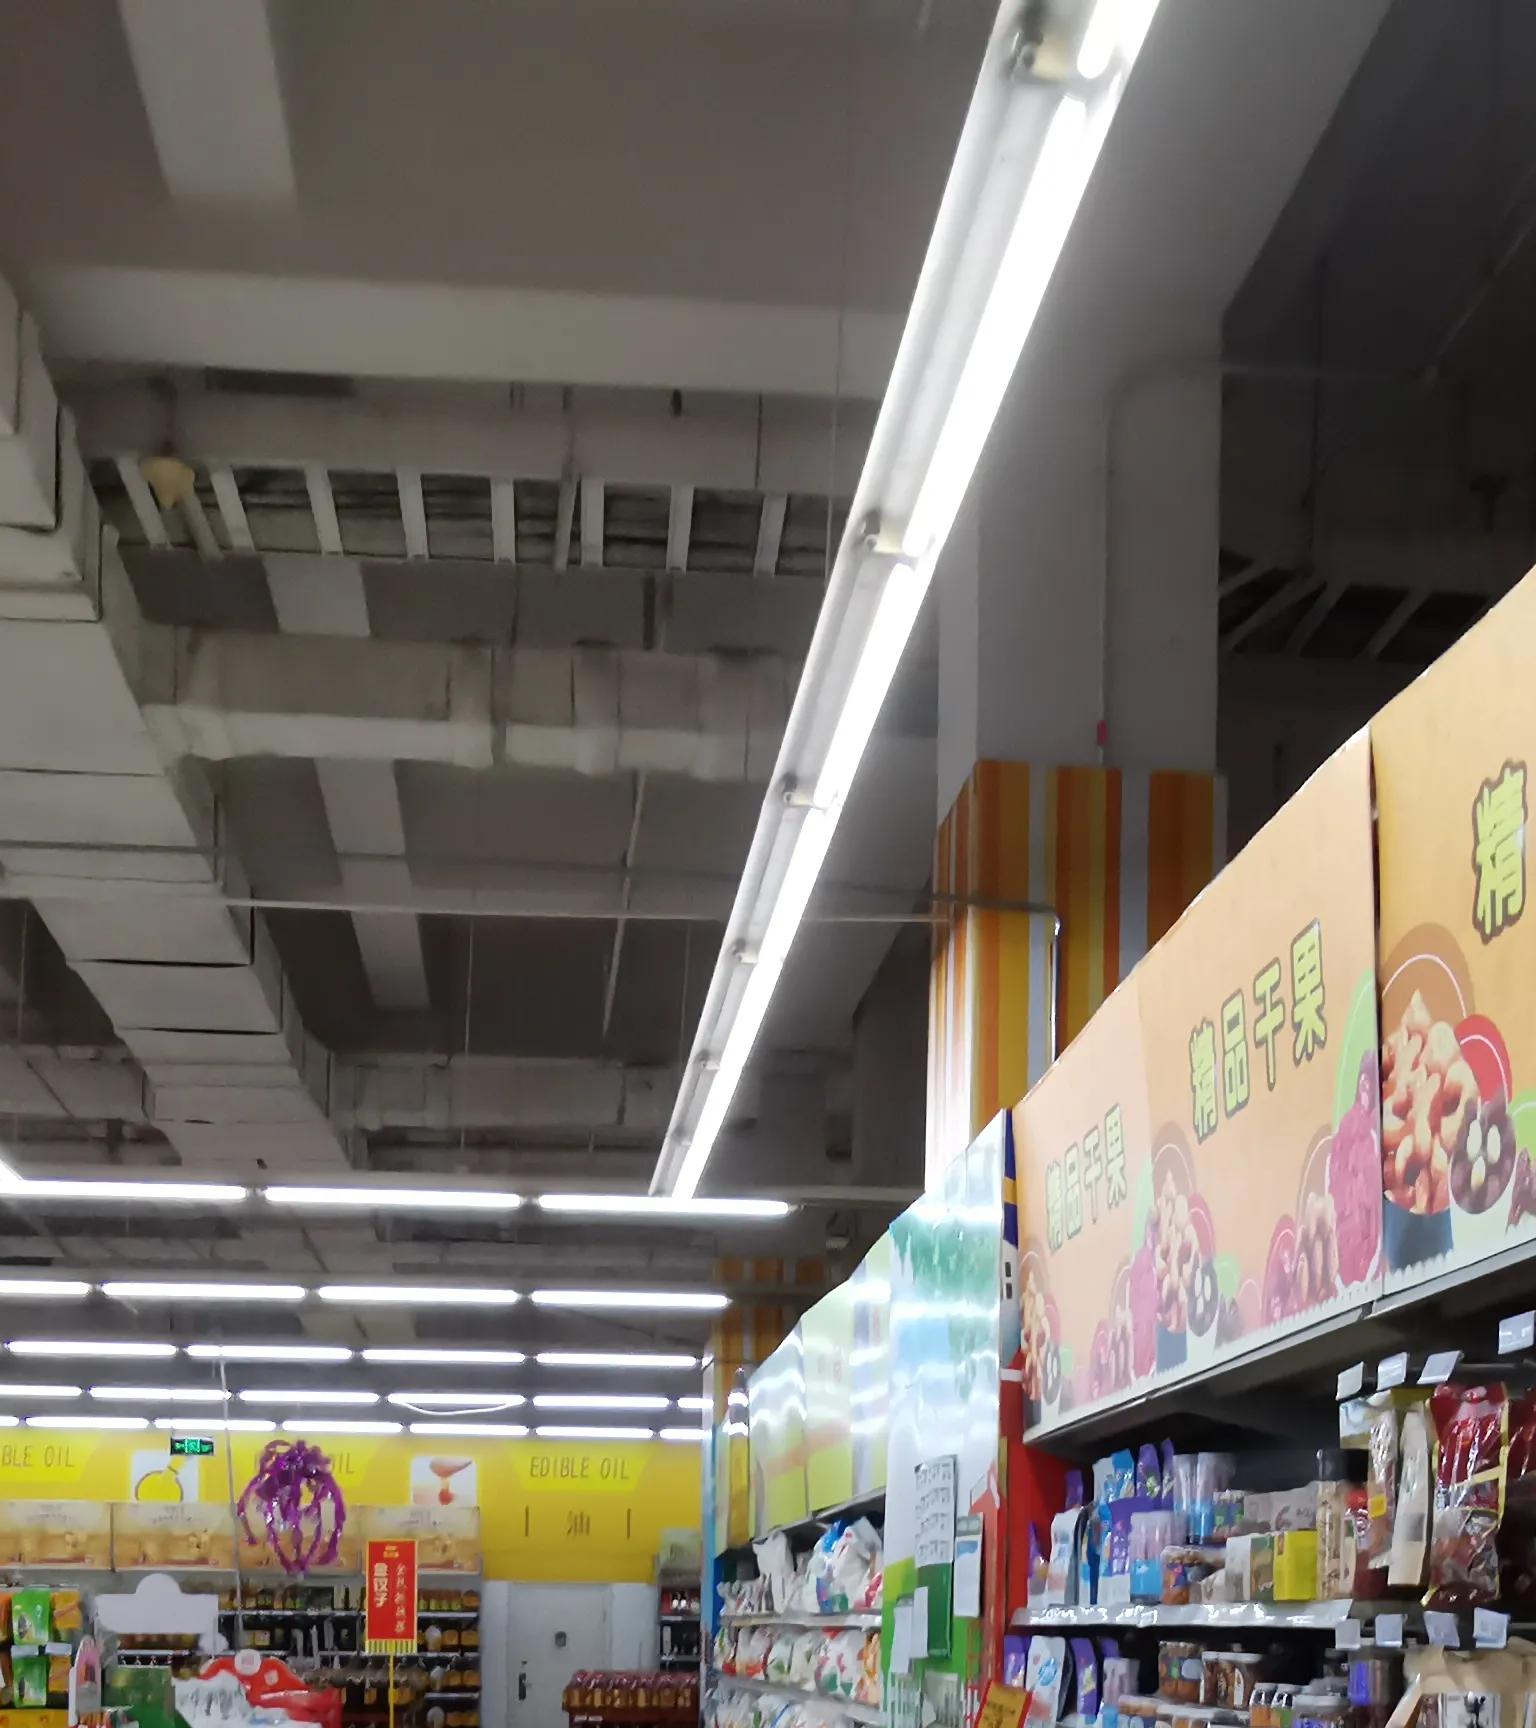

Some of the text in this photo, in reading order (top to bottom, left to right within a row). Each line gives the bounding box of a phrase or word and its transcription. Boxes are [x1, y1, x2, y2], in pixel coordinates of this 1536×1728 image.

[1191, 920, 1327, 1144] 精品干果
[1045, 1105, 1128, 1254] 精品干果
[44, 1446, 75, 1467] OIL
[530, 1456, 630, 1479] EDIBLE OIL
